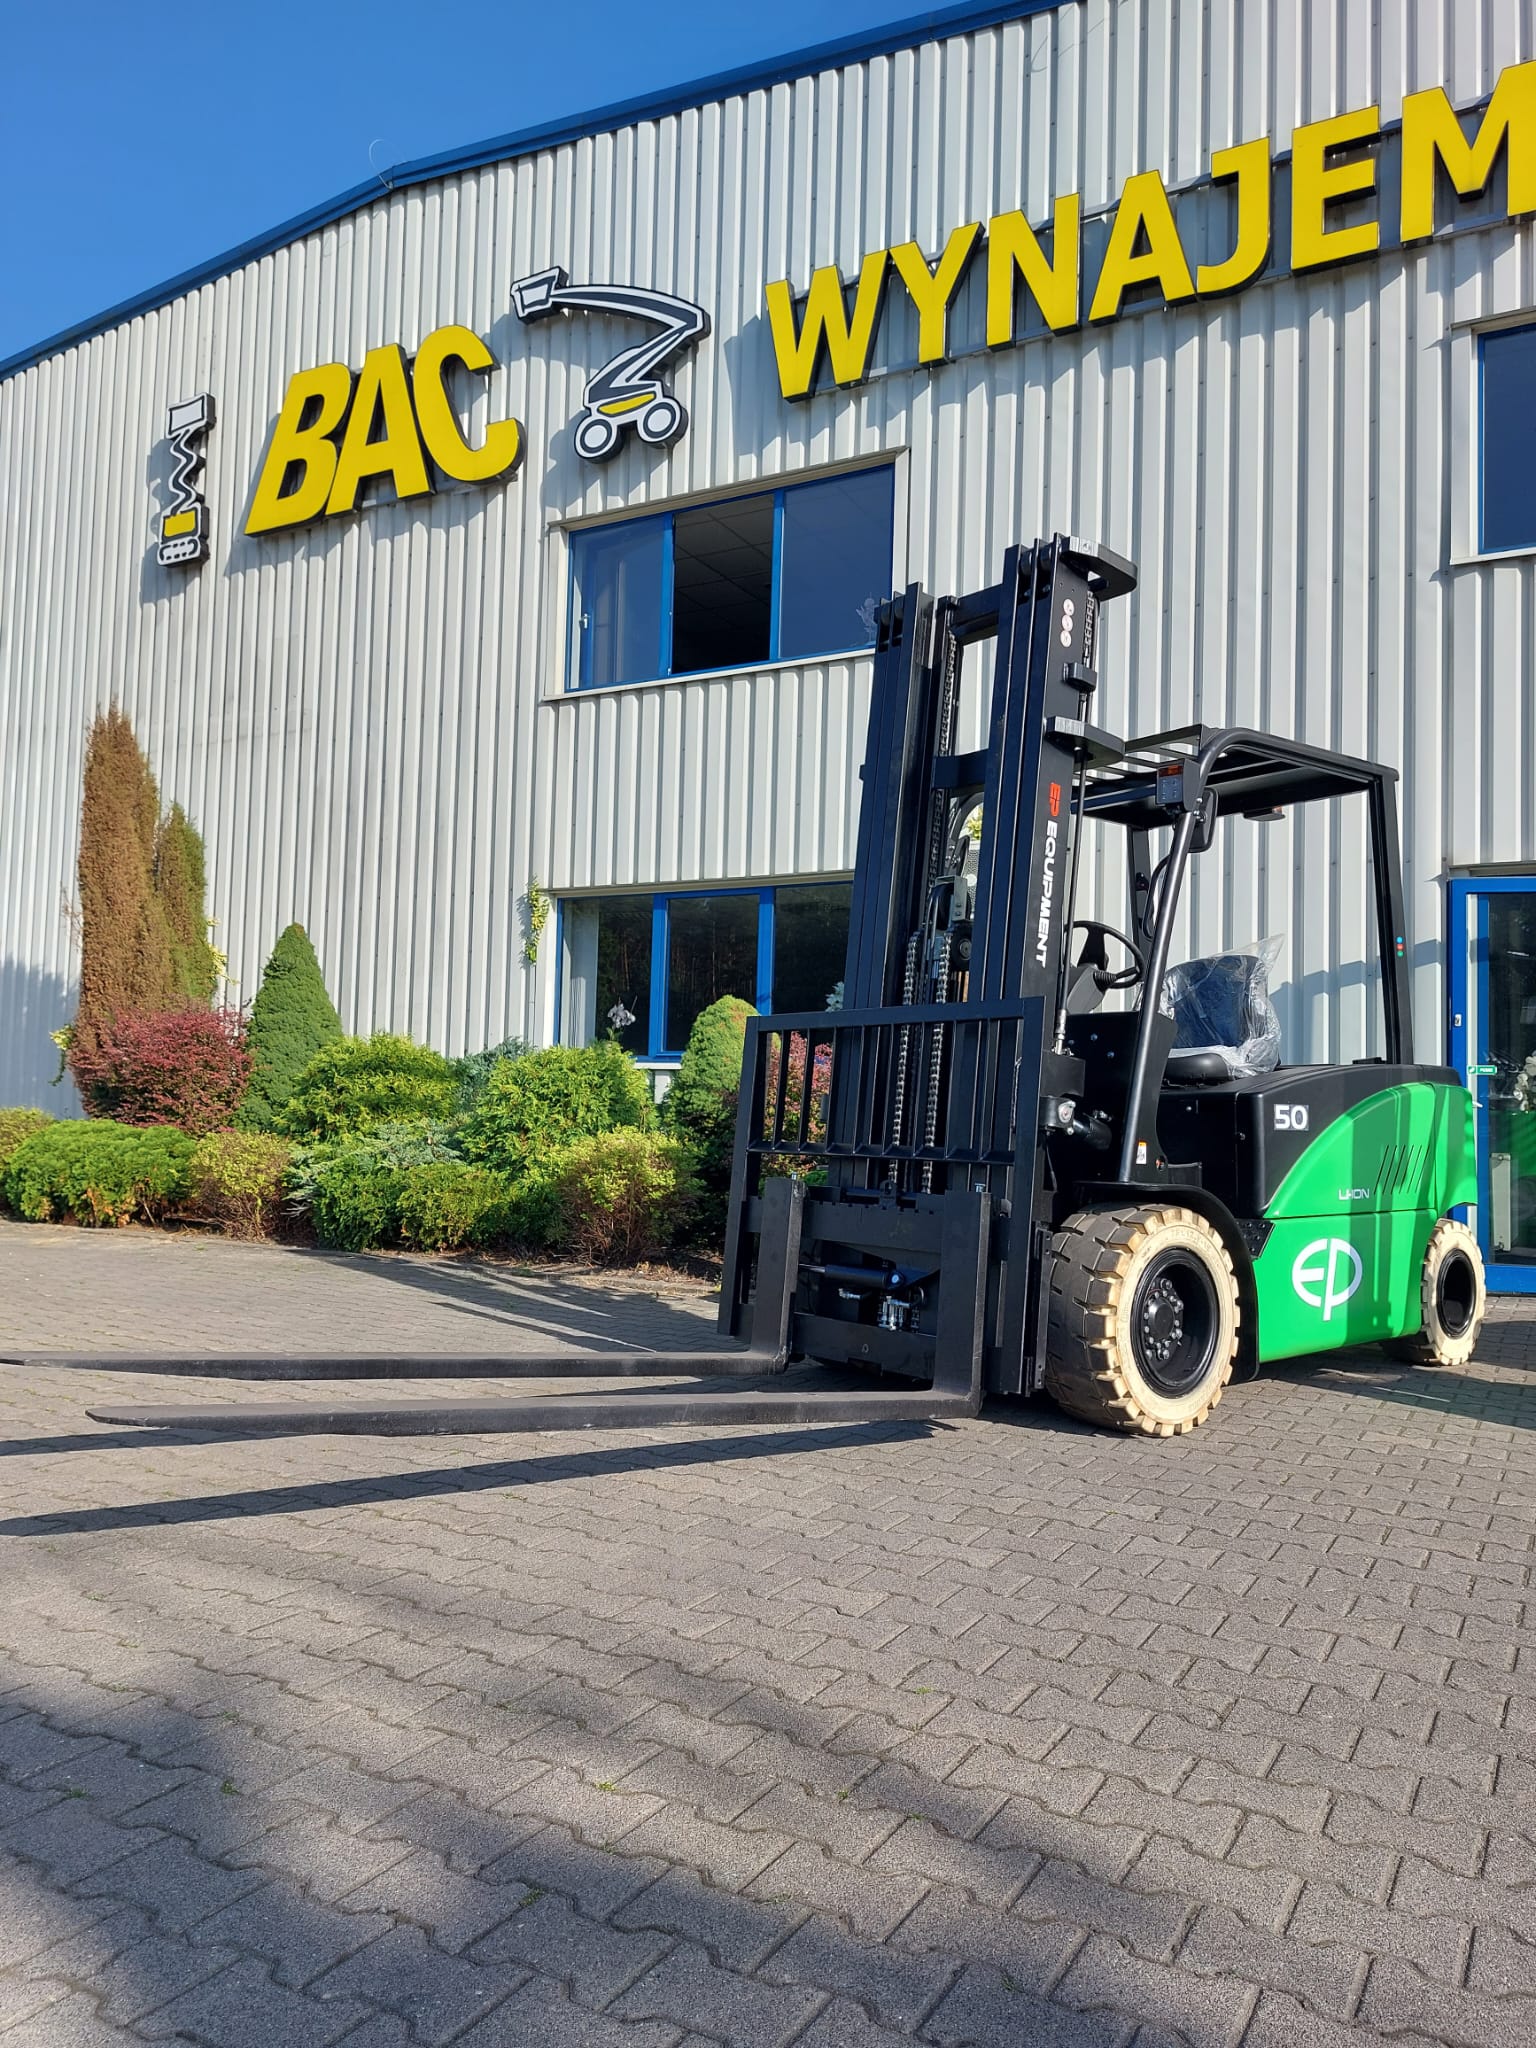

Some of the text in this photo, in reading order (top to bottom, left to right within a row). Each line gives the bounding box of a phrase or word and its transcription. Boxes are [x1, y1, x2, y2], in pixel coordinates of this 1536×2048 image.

[244, 60, 1536, 535] BAC WYNAJEM
[1035, 820, 1058, 968] EQUIPMENT
[1274, 1104, 1308, 1130] 50
